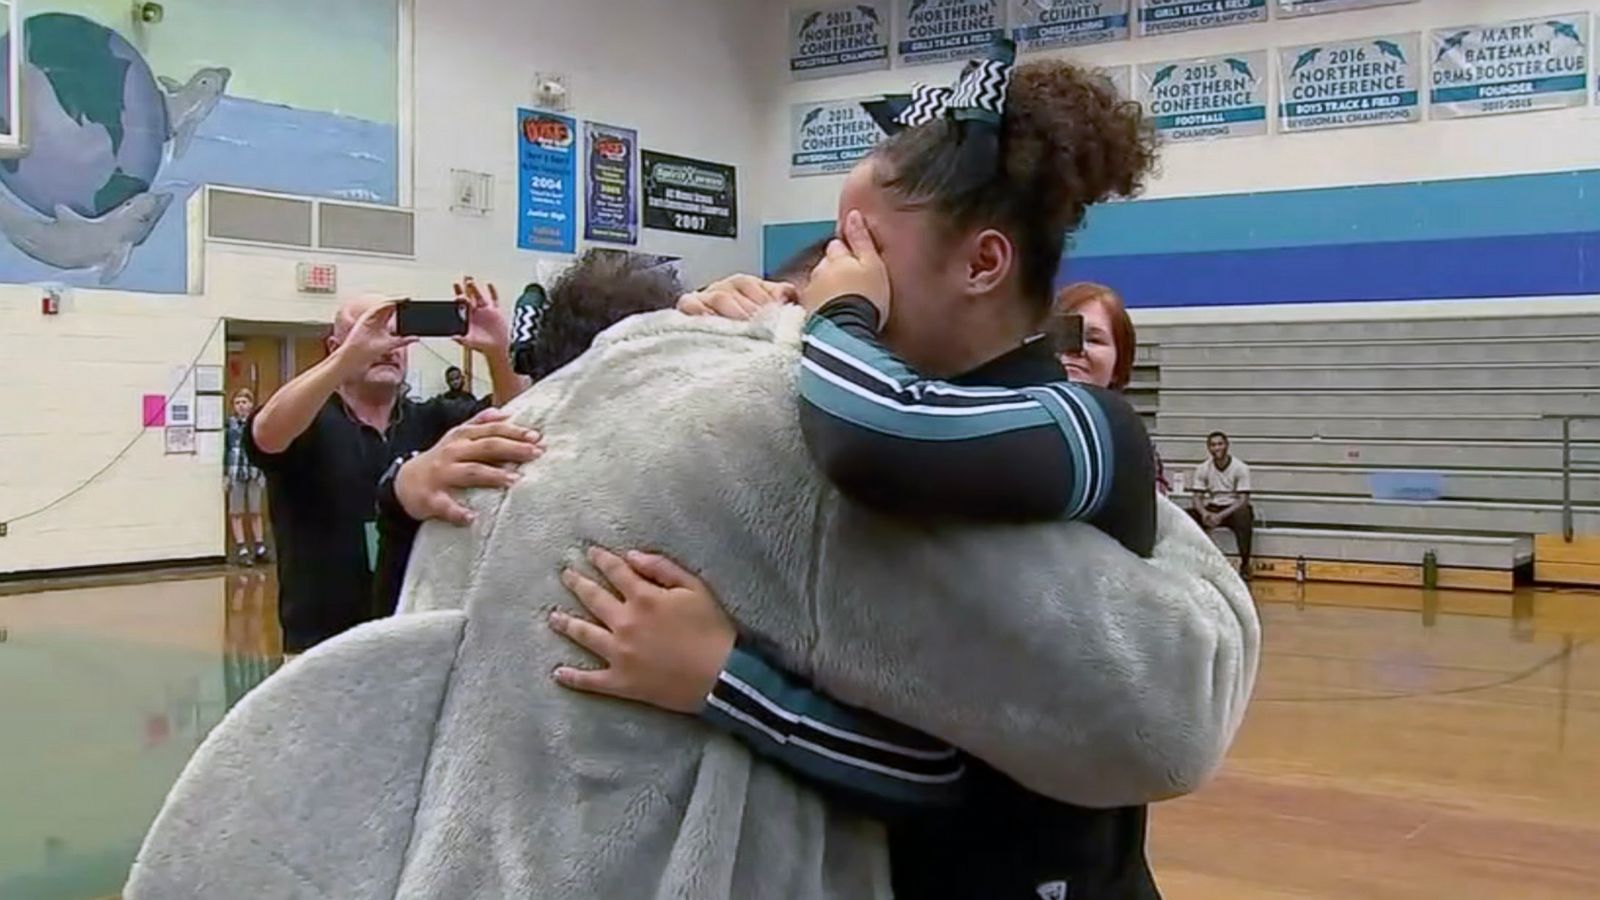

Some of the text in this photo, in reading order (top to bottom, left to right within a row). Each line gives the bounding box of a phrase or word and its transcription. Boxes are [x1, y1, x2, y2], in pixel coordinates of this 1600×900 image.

[914, 3, 989, 24] NORTHERN
[1039, 3, 1102, 23] COUNTY
[1182, 3, 1214, 15] TRACK
[805, 21, 875, 43] NORTHERN
[908, 15, 995, 38] CONFERENCE
[1481, 23, 1535, 42] MARK
[800, 33, 880, 56] CONFERENCE
[1464, 41, 1551, 63] BATEMAN
[1329, 48, 1366, 65] 2016
[1184, 65, 1218, 81] 2015
[1299, 60, 1397, 83] NORTHERN
[1476, 58, 1544, 81] BOOSTER
[1545, 54, 1586, 74] CLUB
[1156, 77, 1245, 99] NORTHERN
[1292, 75, 1406, 100] CONFERENCE
[1478, 82, 1534, 98] FOUNDER
[1150, 91, 1252, 115] CONFERENCE
[1295, 103, 1323, 115] BOYS
[1325, 99, 1360, 112] TRACK
[1372, 95, 1401, 107] FIELD
[806, 120, 875, 137] NORTHERN
[1174, 112, 1225, 126] FOOTBALL
[1171, 126, 1231, 139] CHAMPIONS
[674, 213, 706, 230] 2007
